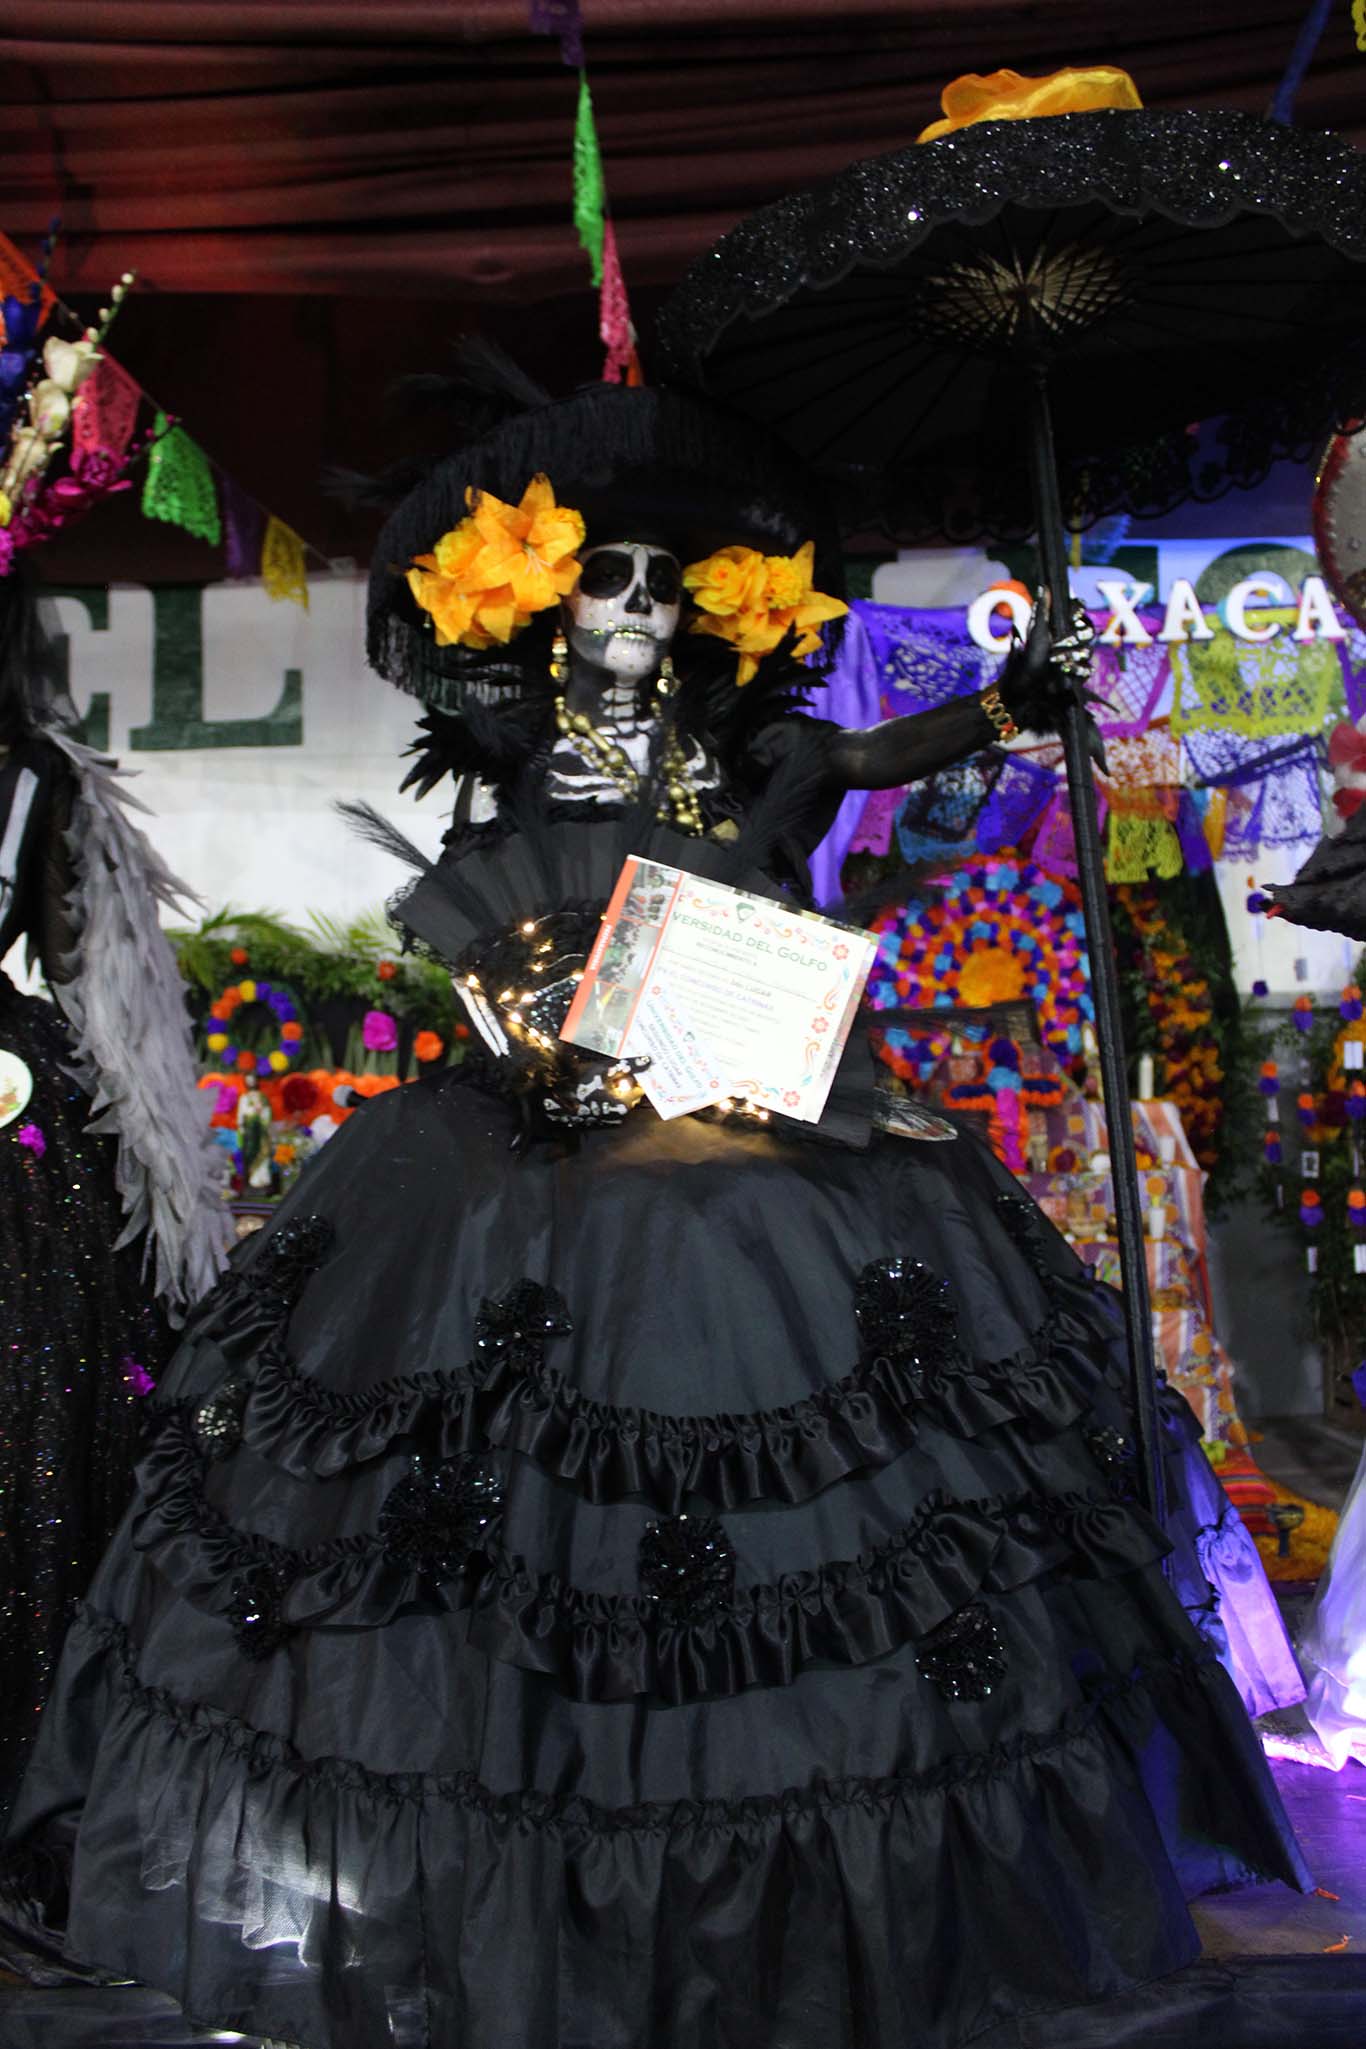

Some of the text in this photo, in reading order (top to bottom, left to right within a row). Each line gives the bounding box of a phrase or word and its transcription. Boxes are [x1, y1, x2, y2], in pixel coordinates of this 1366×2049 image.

[967, 577, 1347, 653] OXACA
[747, 937, 773, 954] DEL
[777, 946, 829, 972] GOLFO
